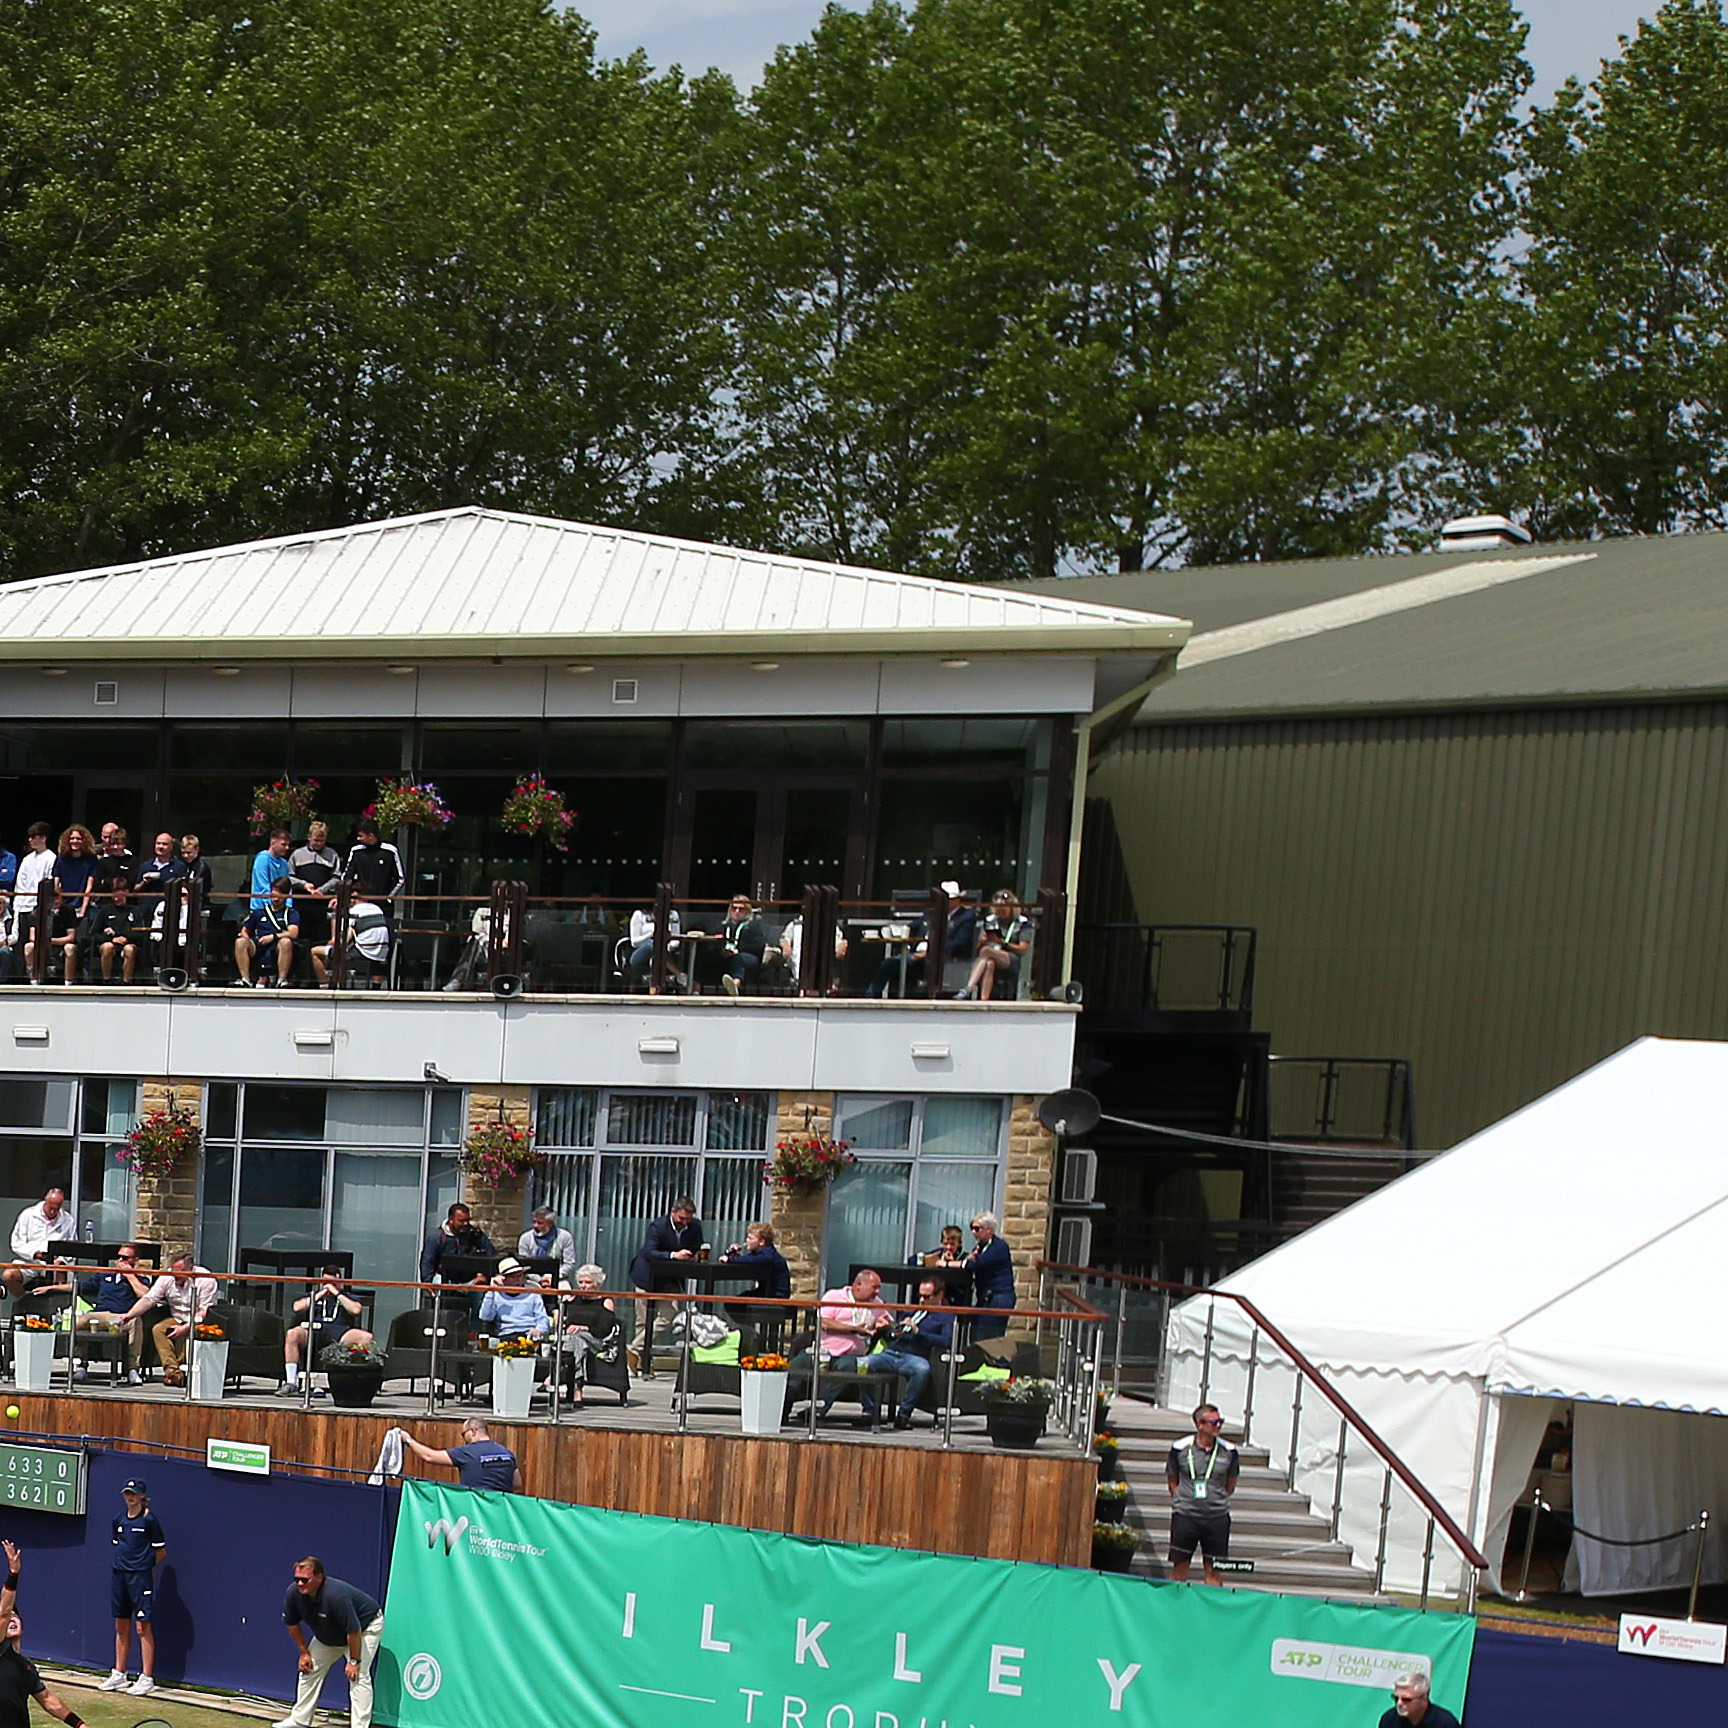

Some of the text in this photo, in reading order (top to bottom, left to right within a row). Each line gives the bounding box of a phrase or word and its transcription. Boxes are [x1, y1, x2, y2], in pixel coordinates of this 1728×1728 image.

[9, 1456, 17, 1471] 6
[22, 1457, 31, 1473] 3
[35, 1459, 43, 1475] 3
[58, 1461, 67, 1478] 0
[7, 1484, 16, 1499] 3
[20, 1485, 29, 1501] 6
[33, 1487, 41, 1503] 2
[57, 1489, 66, 1506] 0
[621, 1591, 1142, 1712] ILKLEY
[1279, 1651, 1424, 1673] ATP CHALLENGER
[1335, 1664, 1373, 1678] TOUR
